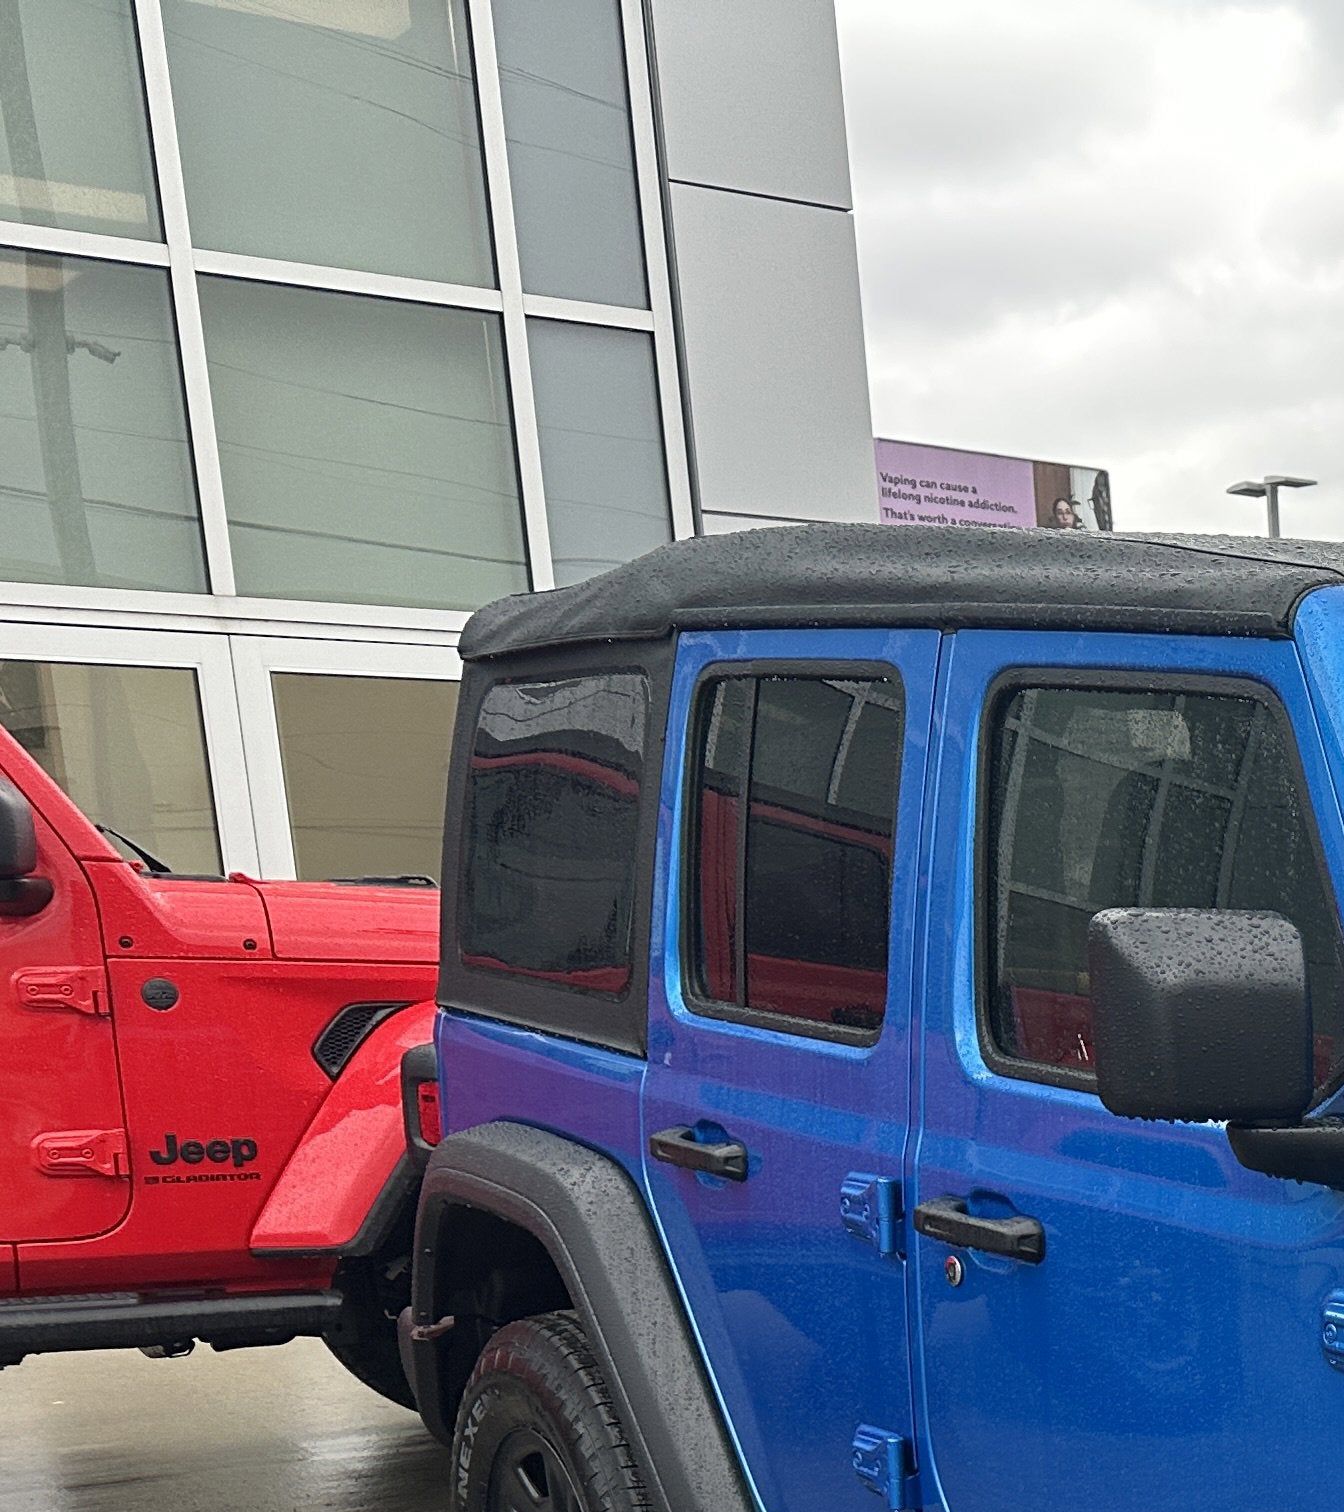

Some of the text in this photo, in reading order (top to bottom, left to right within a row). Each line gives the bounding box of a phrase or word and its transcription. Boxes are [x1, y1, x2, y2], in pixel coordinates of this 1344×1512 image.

[880, 472, 978, 494] Vaping can cause a
[881, 486, 1018, 514] lifelong nicotine addiction.
[883, 507, 915, 521] That's
[917, 512, 948, 525] worth
[951, 517, 957, 526] a
[149, 1132, 258, 1168] Jeep
[161, 1172, 262, 1184] GLADIATOR
